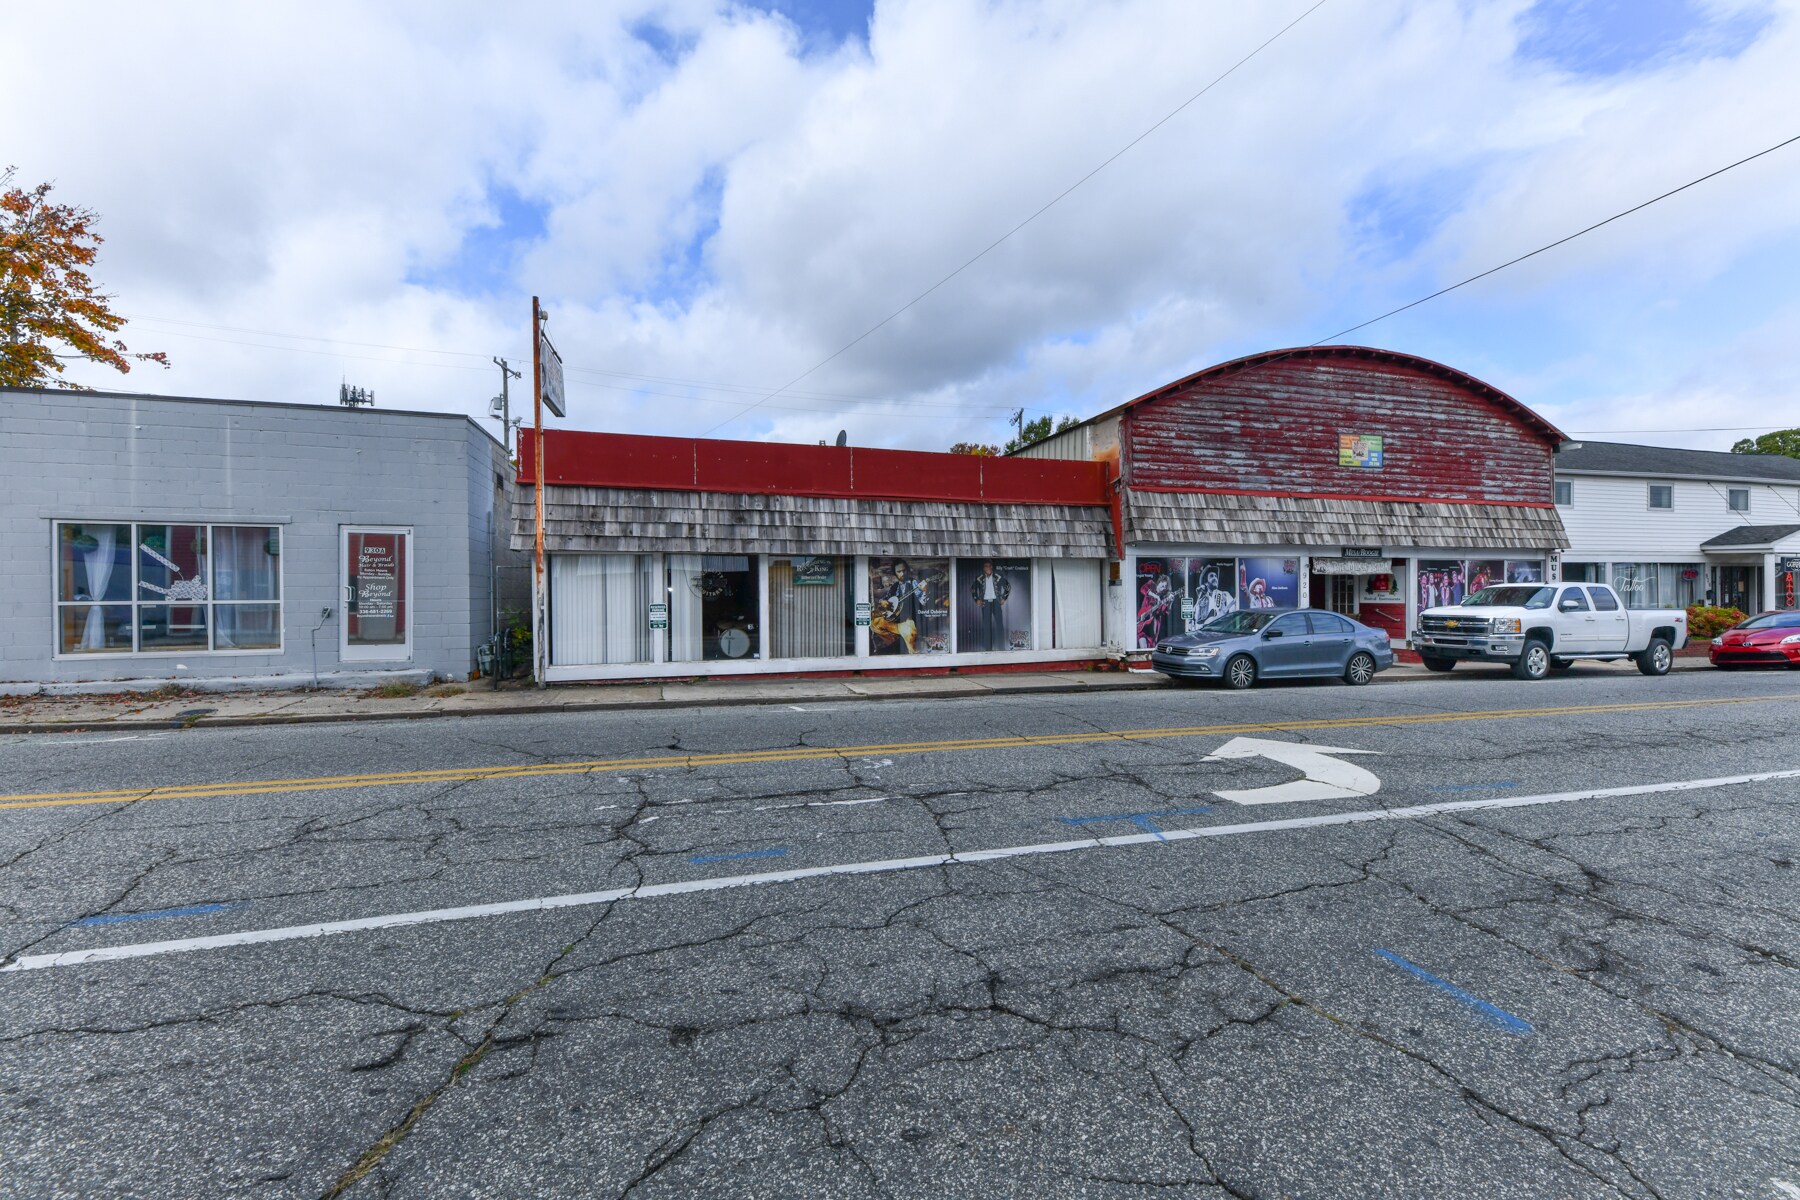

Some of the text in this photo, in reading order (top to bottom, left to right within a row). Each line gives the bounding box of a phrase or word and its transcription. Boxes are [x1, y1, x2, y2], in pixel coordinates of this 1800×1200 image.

[359, 555, 392, 563] Beyond
[1139, 564, 1160, 573] OPEN
[365, 583, 387, 592] Shop
[1614, 576, 1656, 592] Tattoo
[1786, 571, 1794, 606] ATTOO
[358, 590, 392, 598] Beyond
